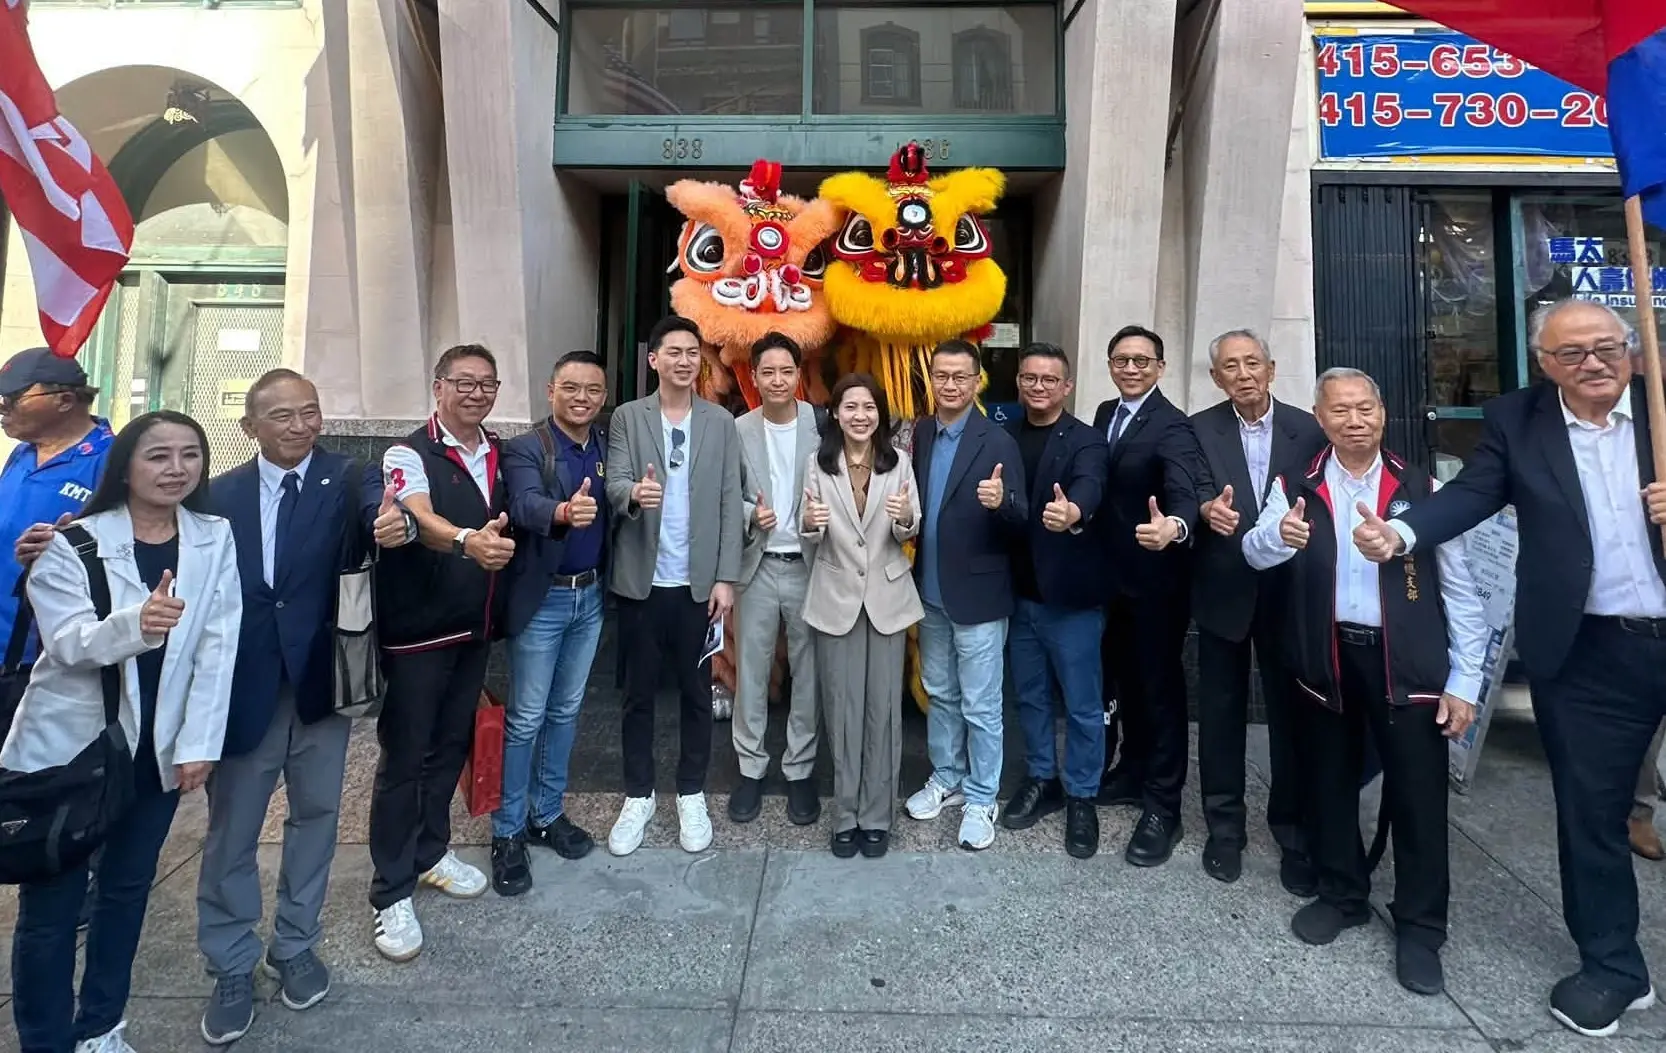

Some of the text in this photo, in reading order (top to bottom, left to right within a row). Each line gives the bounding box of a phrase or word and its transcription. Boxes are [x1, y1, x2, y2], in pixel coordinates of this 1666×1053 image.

[662, 138, 702, 159] 838
[911, 138, 950, 160] 36
[1605, 294, 1666, 307] Insun
[58, 482, 93, 502] KMT
